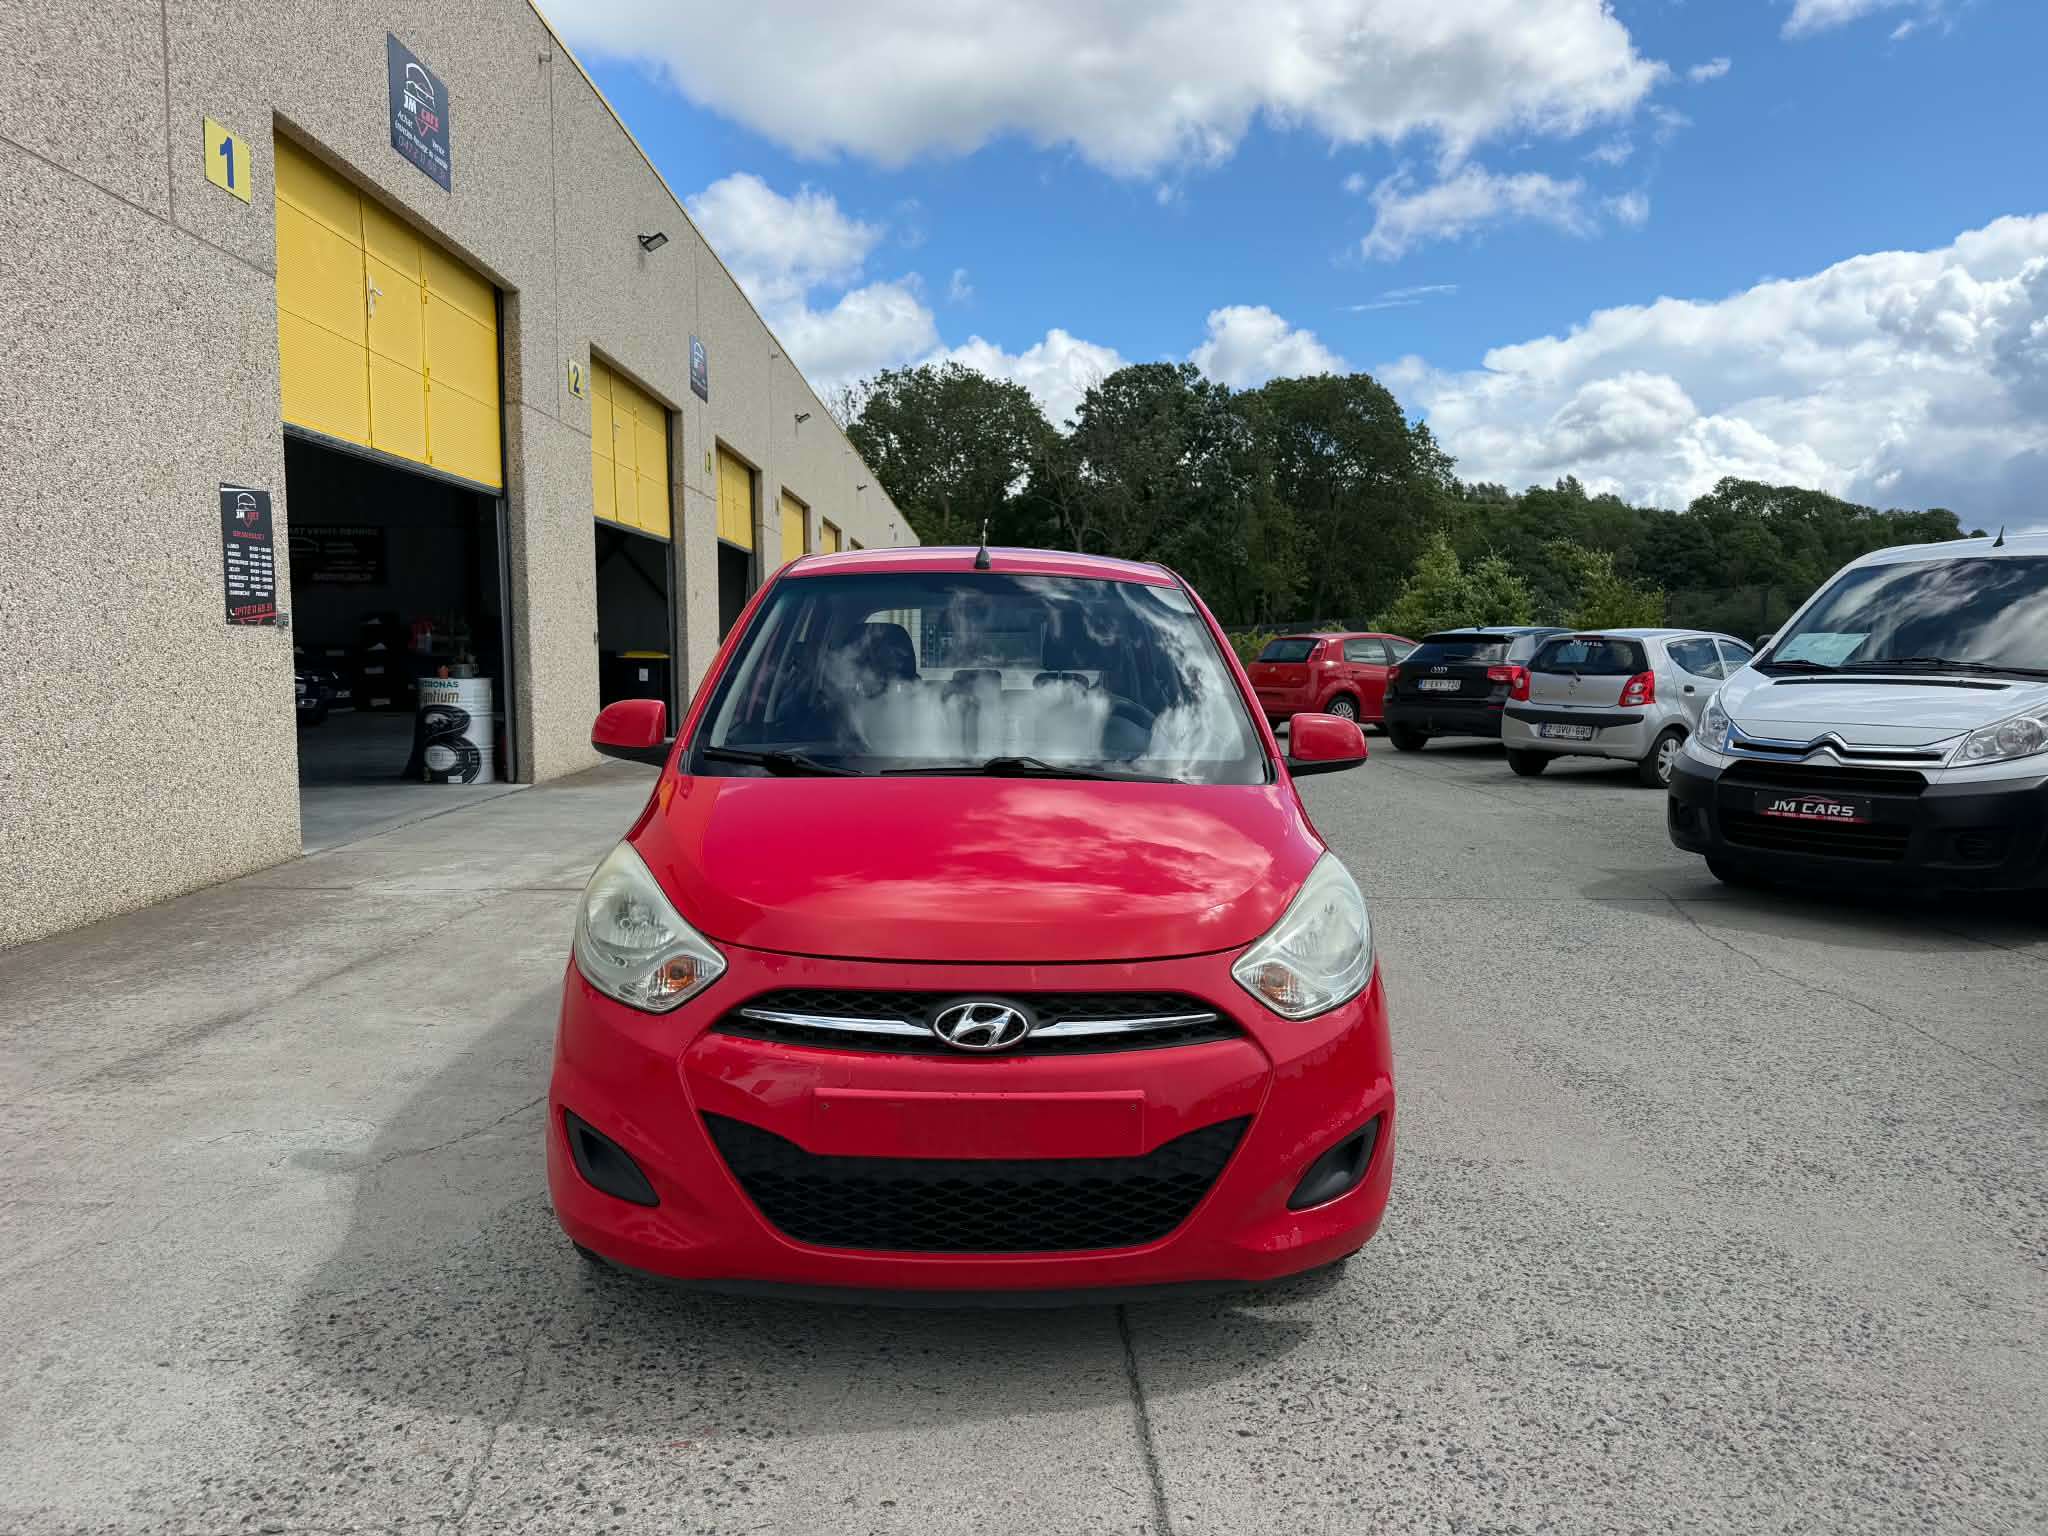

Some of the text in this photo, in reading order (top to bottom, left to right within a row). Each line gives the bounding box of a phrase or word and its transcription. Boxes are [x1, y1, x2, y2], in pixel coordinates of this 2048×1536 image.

[219, 135, 234, 189] 1
[572, 364, 580, 393] 2
[1768, 800, 1796, 812] JM
[1802, 803, 1855, 817] CARS
